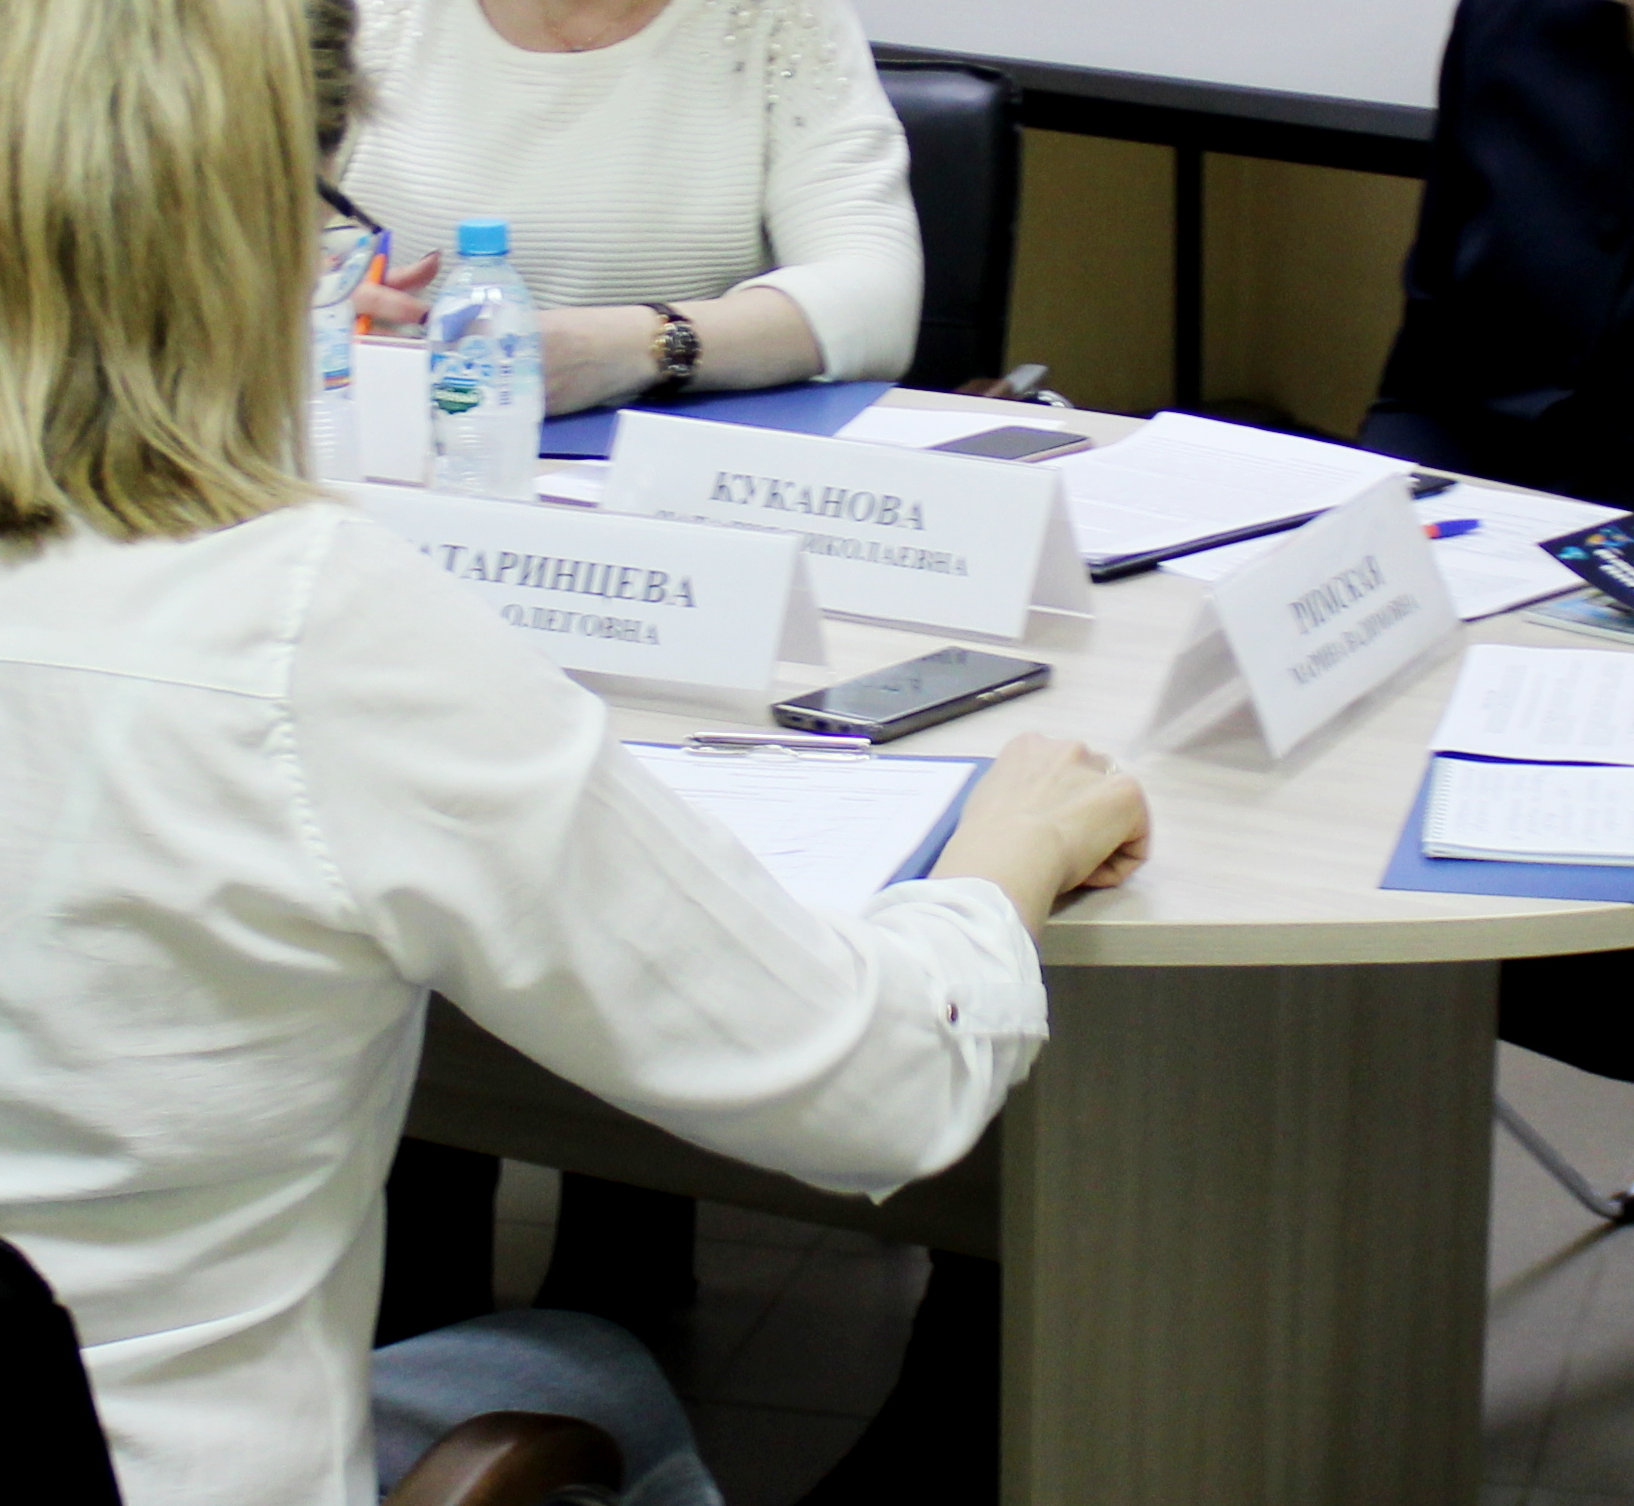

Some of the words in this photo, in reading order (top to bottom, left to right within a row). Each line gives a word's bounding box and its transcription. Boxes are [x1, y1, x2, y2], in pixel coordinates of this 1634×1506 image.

[709, 470, 925, 531] КУКАНОВА
[414, 540, 698, 608] ТАРИНЦЕВА
[796, 530, 969, 577] ИКОЛАЕВНА
